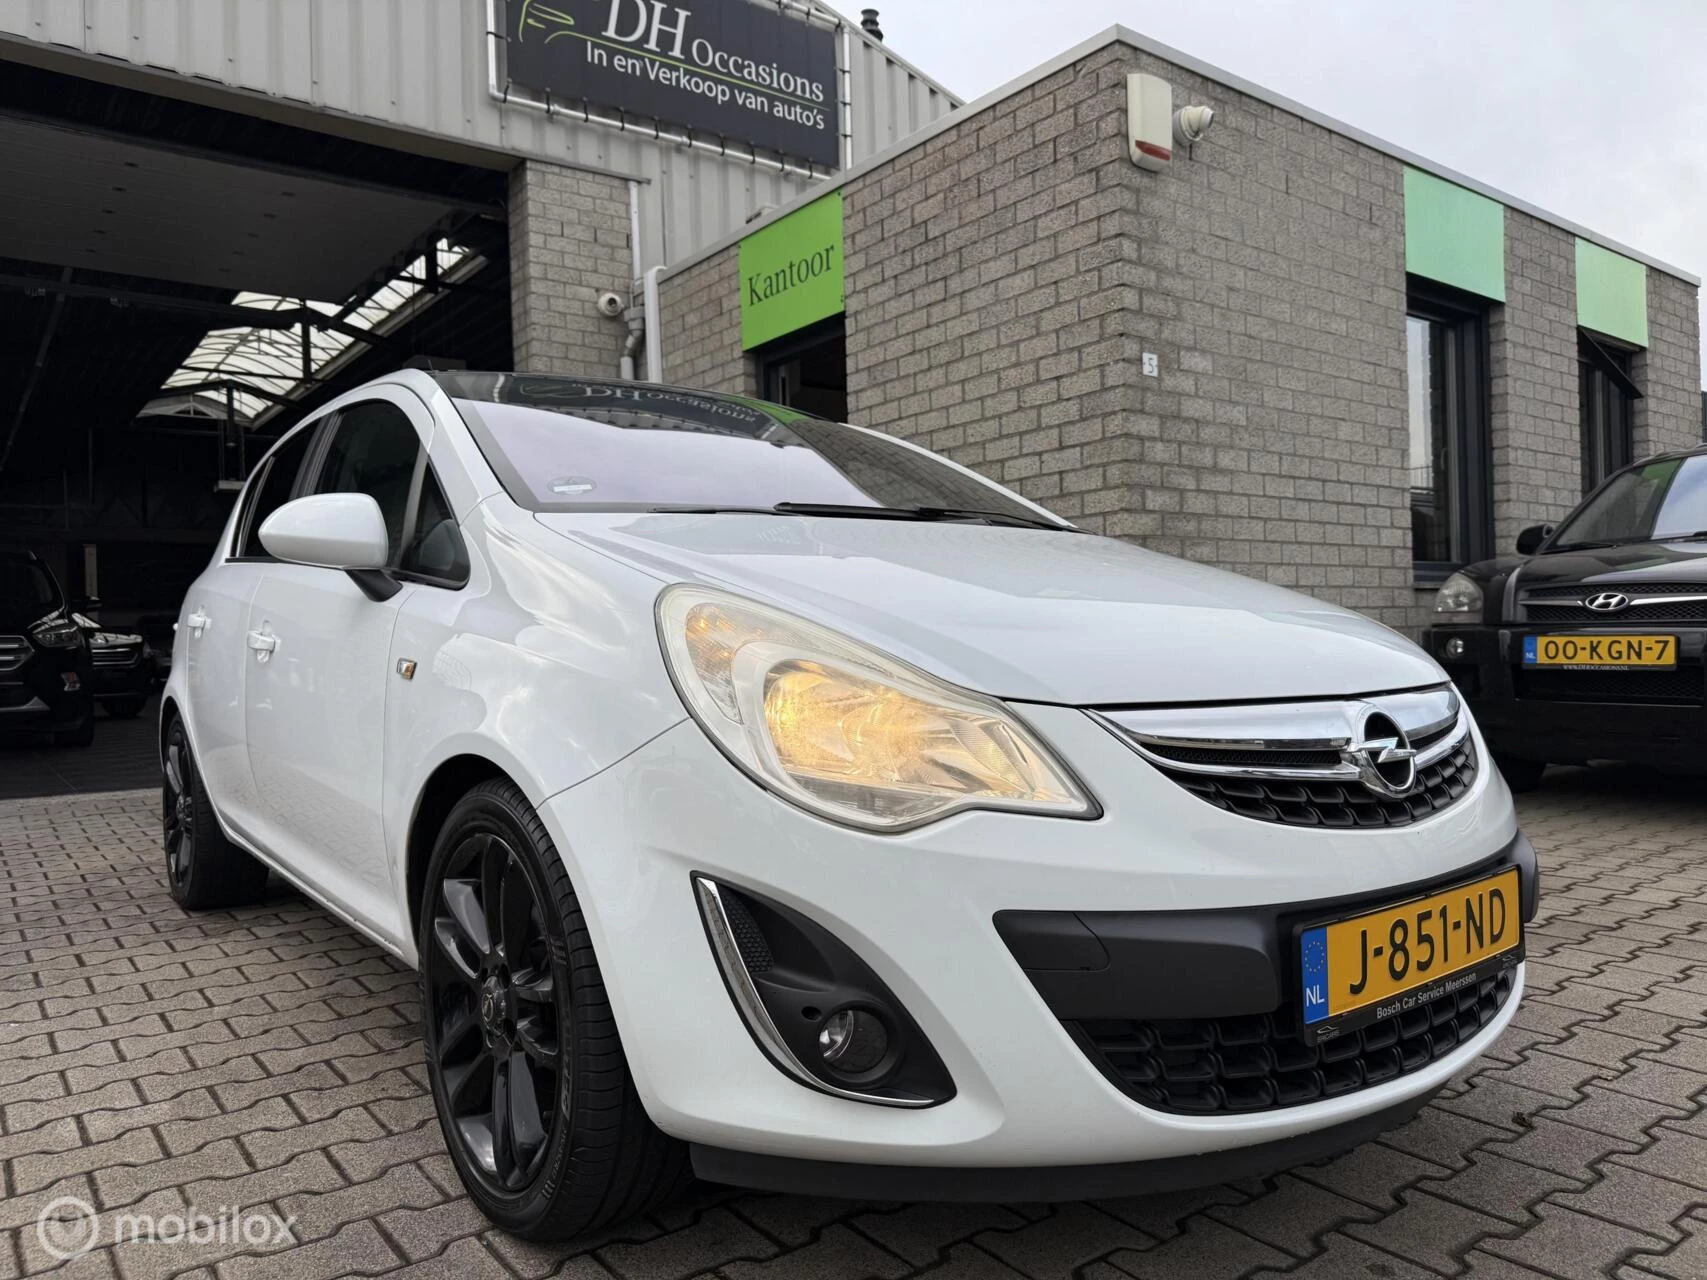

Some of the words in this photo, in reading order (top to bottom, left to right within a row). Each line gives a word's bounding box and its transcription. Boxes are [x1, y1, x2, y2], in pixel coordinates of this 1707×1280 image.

[602, 0, 691, 59] DH
[692, 38, 824, 102] Occasions
[586, 41, 607, 66] In
[613, 55, 641, 77] en
[643, 57, 730, 104] Verkoop
[734, 88, 768, 113] van
[773, 101, 825, 130] auto's
[746, 244, 835, 306] Kantoor
[1526, 652, 1536, 660] NL
[1543, 639, 1670, 661] 00-KGN-7
[1349, 888, 1505, 995] J-851-ND
[1306, 985, 1325, 1007] NL
[1376, 1001, 1401, 1019] Bosch
[1402, 994, 1416, 1010] Car
[1417, 986, 1444, 1003] Service
[1445, 973, 1477, 992] Meerssen
